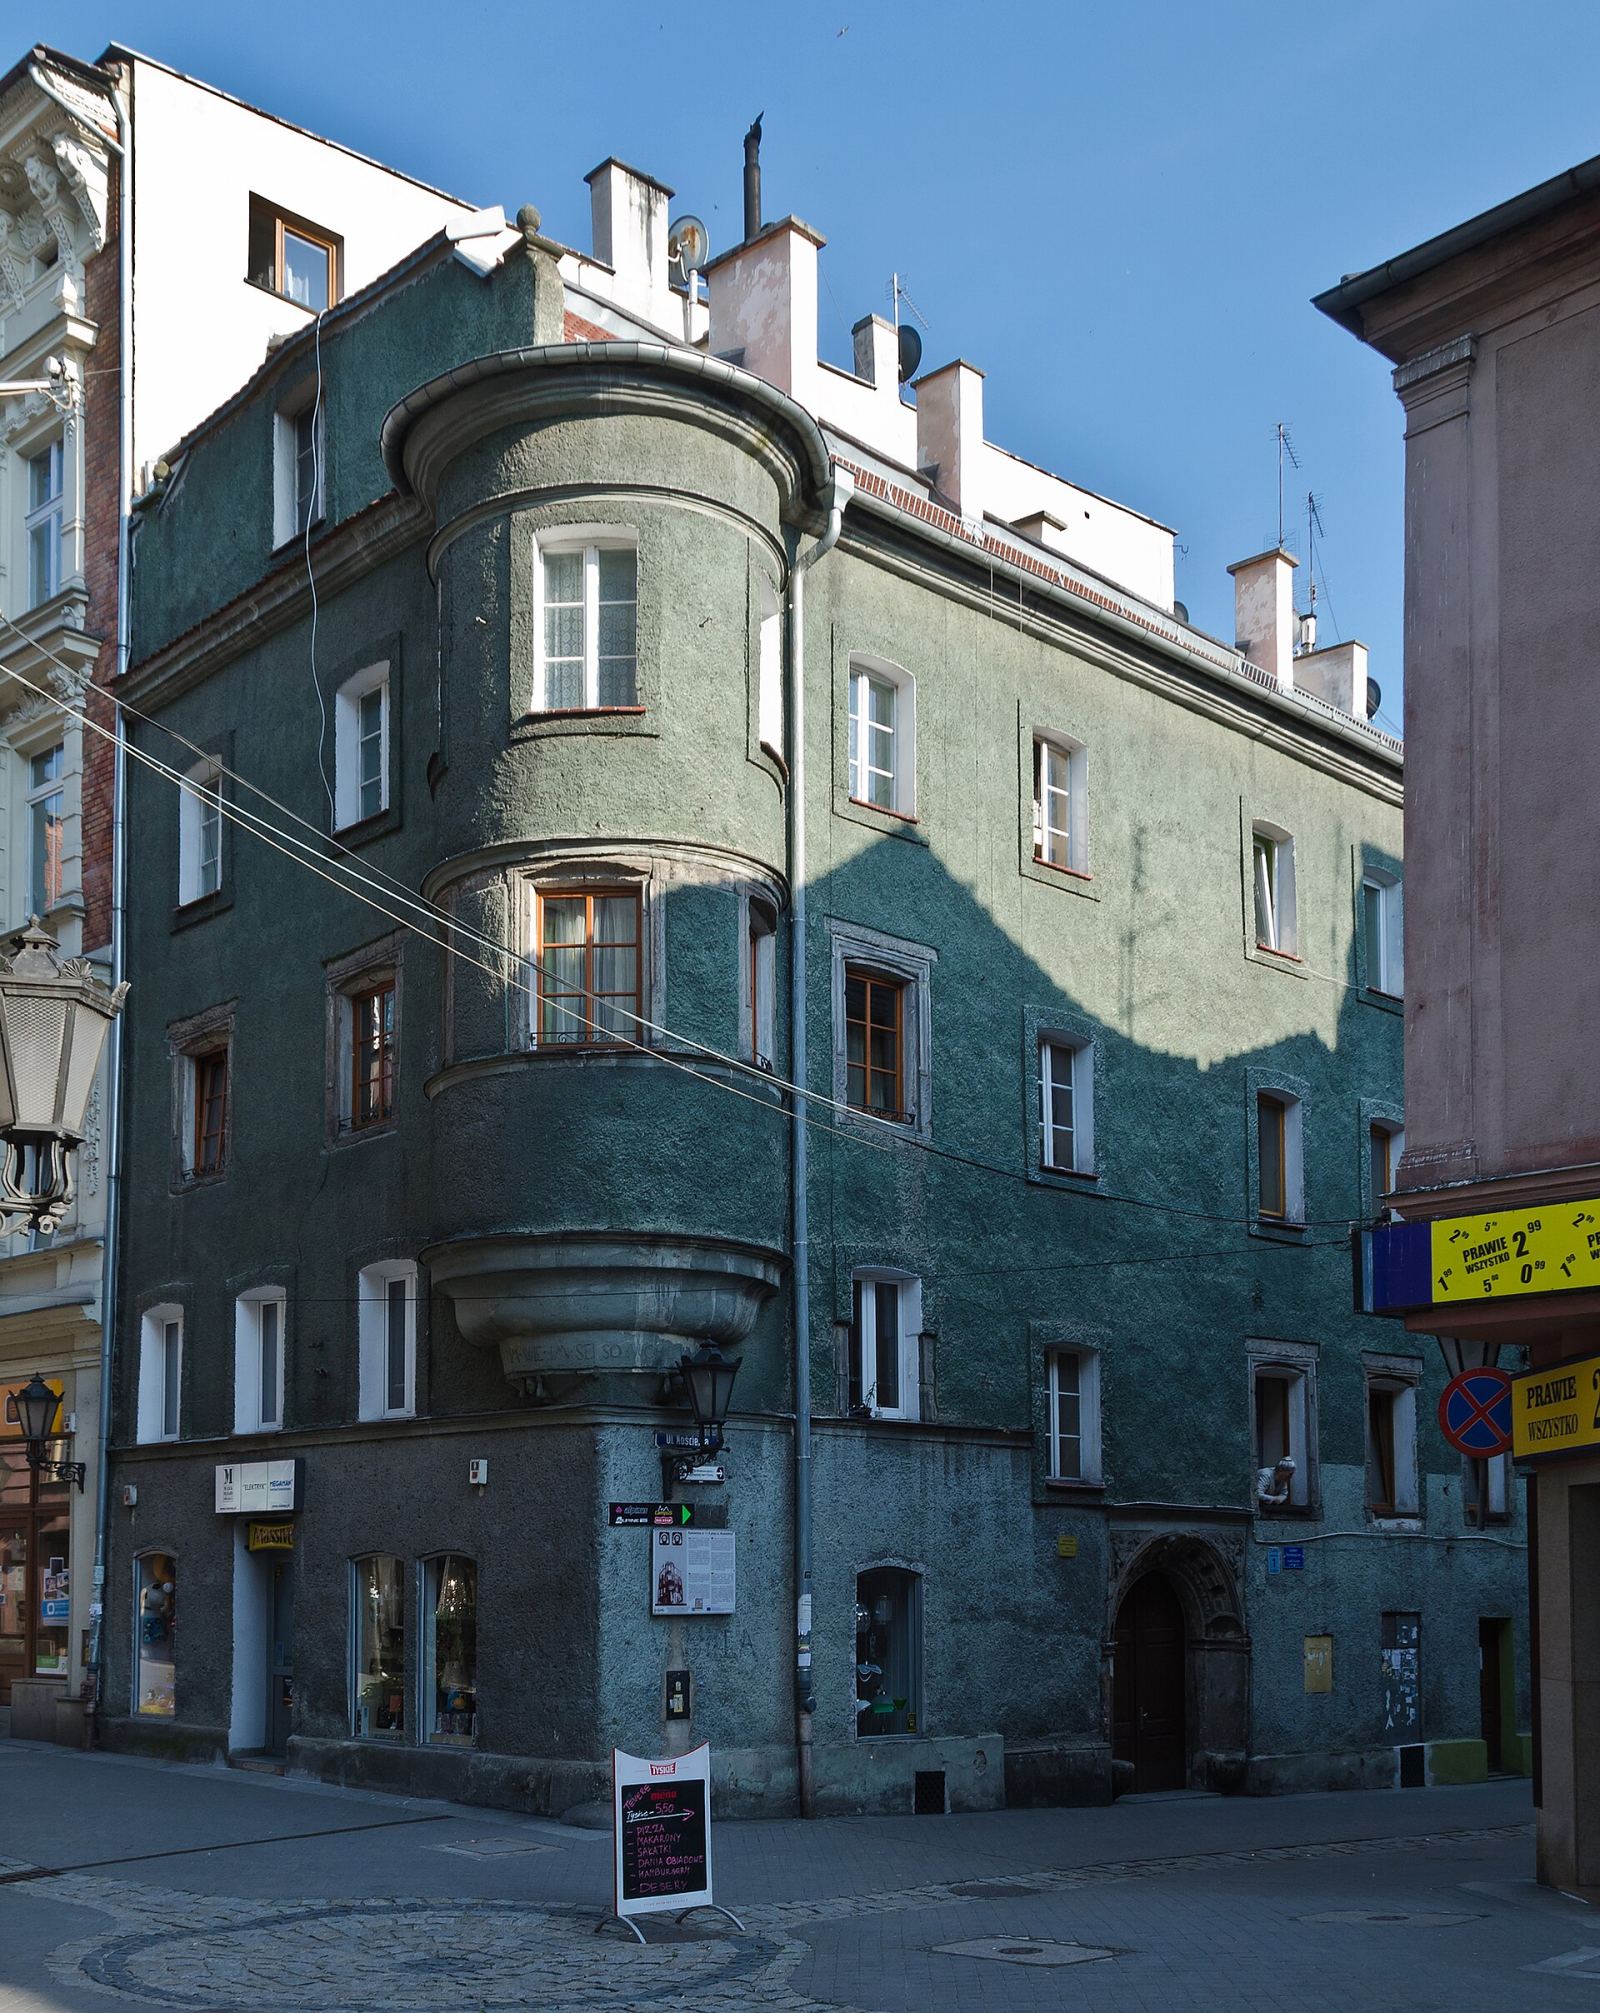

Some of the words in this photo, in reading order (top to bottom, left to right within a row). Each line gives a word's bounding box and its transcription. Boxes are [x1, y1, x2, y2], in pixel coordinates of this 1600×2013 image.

[1462, 1236, 1508, 1263] PRAWIE
[1465, 1251, 1510, 1275] WSZYSTKO
[1526, 1375, 1577, 1410] PRAWIE
[1527, 1413, 1579, 1442] WSZYSTKO
[223, 1468, 233, 1485] M
[651, 1765, 675, 1775] TYSKIE
[623, 1784, 652, 1810] TEVERE
[636, 1824, 665, 1837] PIZZA
[637, 1833, 681, 1846] MAKARONY
[638, 1858, 663, 1868] DANIA
[665, 1855, 704, 1865] OBIADOWE
[639, 1880, 689, 1894] DESERY
